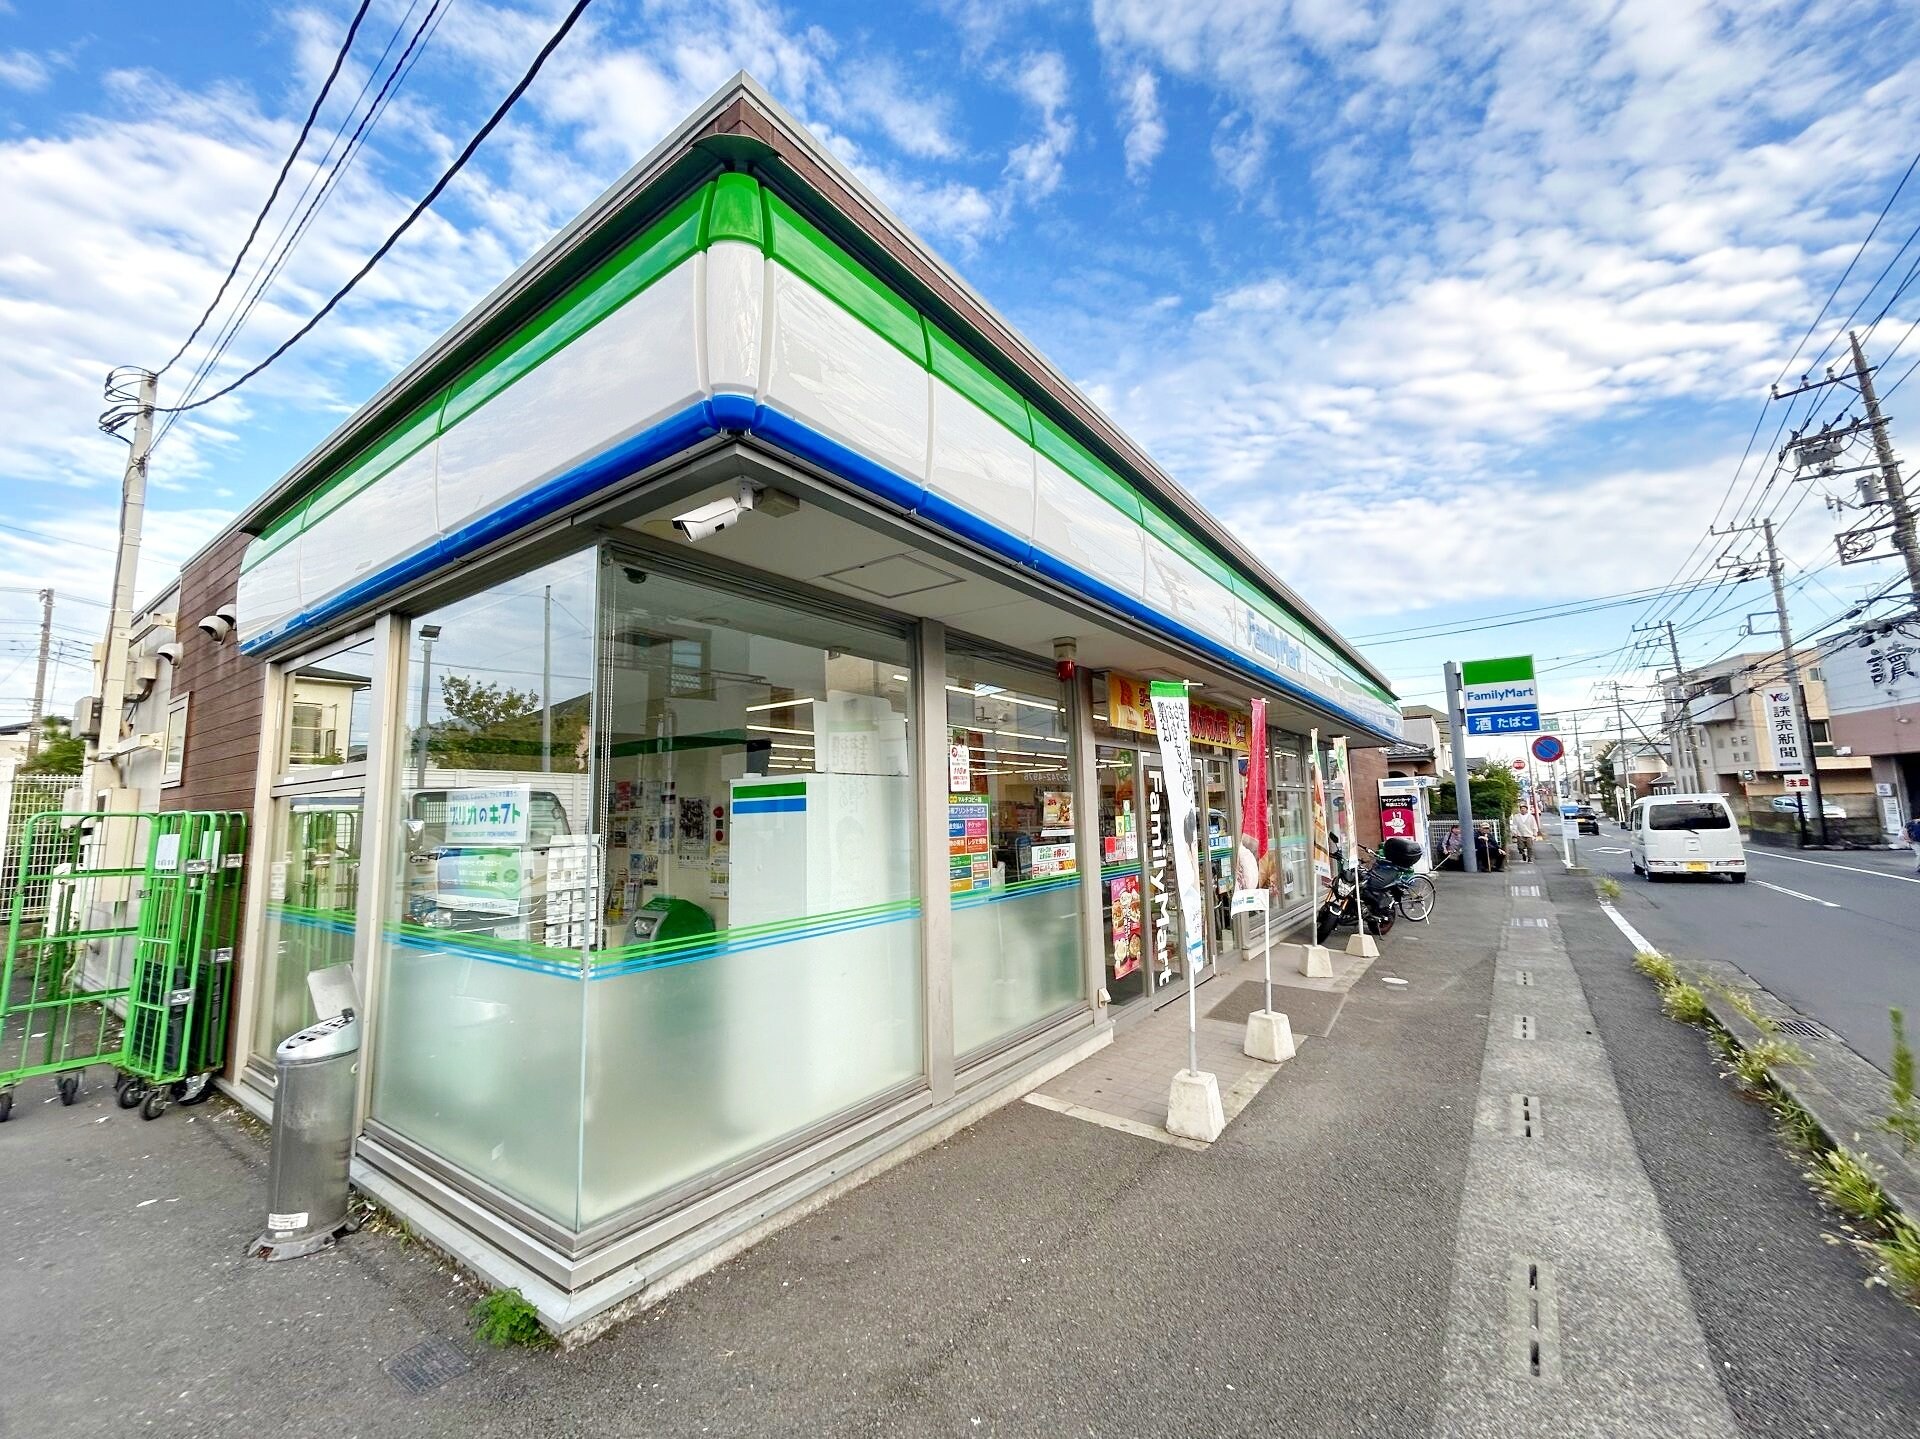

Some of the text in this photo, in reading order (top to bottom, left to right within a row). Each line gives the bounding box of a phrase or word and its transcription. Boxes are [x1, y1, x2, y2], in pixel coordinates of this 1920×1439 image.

[1247, 608, 1302, 674] FamilyMart
[1467, 687, 1534, 702] FamilyMart
[1475, 717, 1492, 731] 酒
[1497, 715, 1533, 729] たばこ
[1773, 705, 1798, 758] 読売新聞
[1785, 778, 1810, 788] 注意
[1148, 770, 1173, 987] FamilyMart
